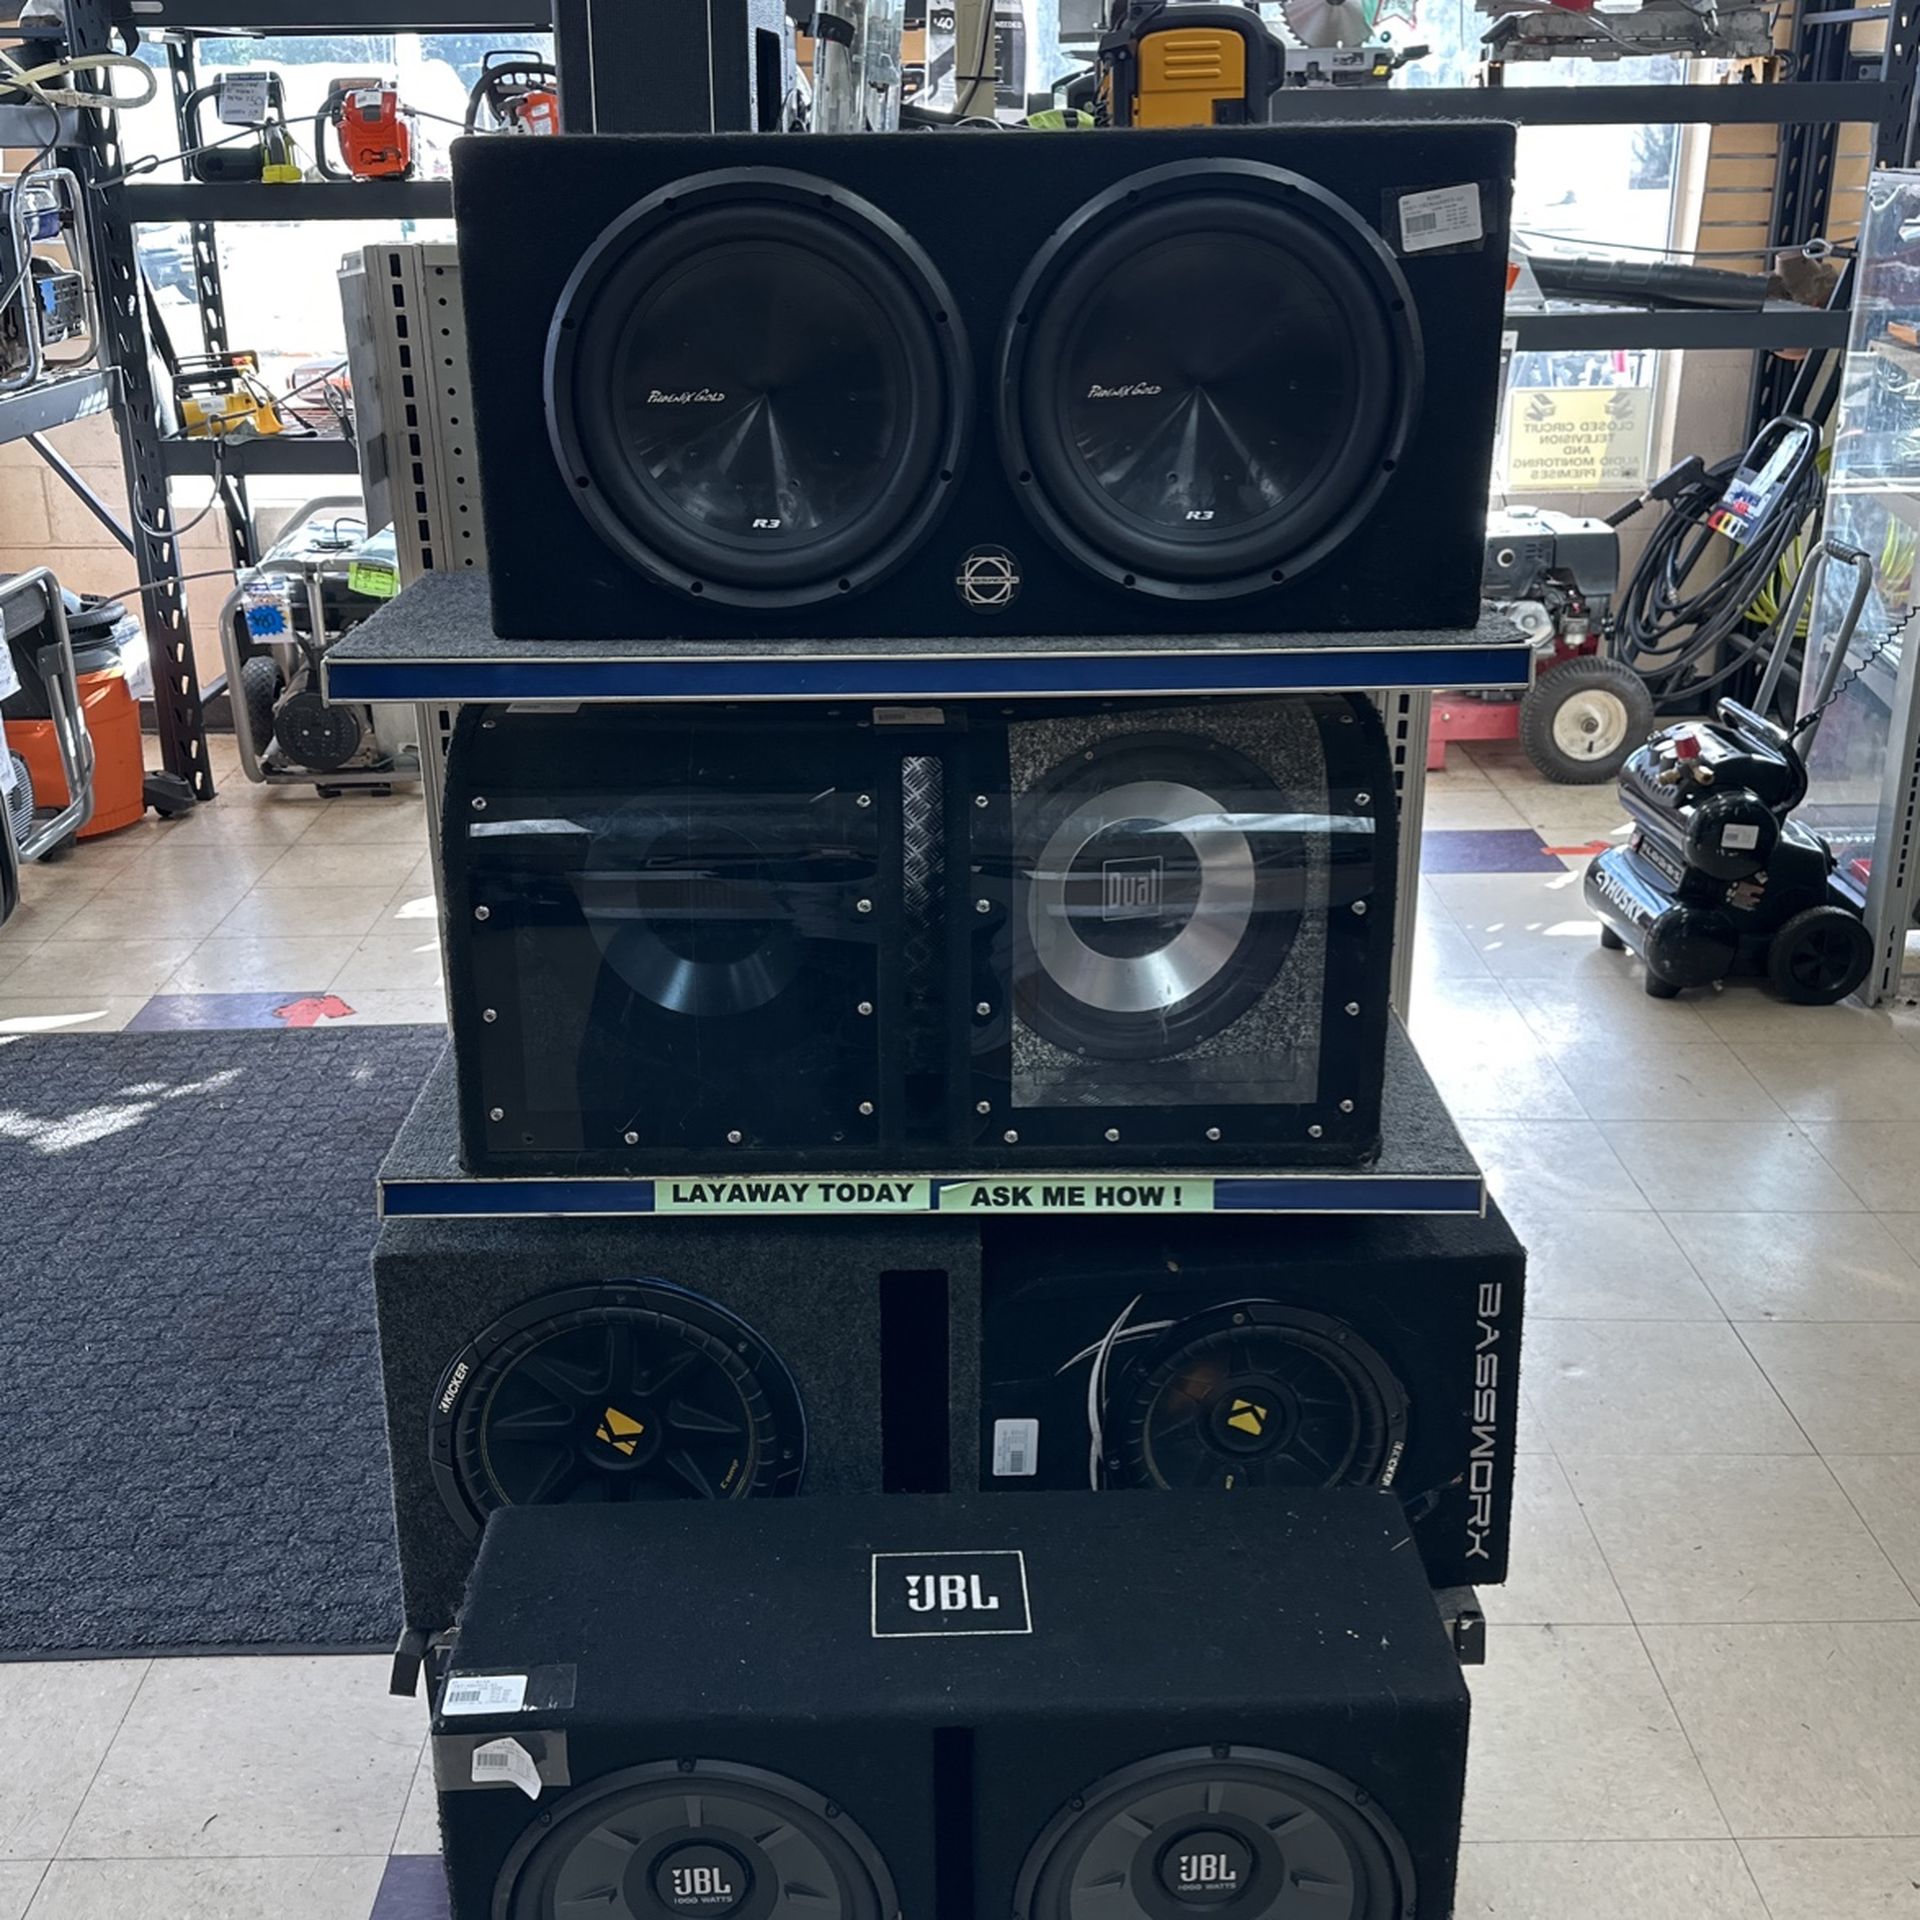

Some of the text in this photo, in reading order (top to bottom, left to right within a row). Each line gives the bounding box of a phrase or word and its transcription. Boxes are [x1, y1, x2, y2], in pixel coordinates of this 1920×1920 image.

[752, 519, 781, 529] R3
[1185, 511, 1215, 520] R3
[1109, 869, 1156, 909] Dual
[1605, 879, 1646, 924] HUSKY
[672, 1184, 915, 1203] LAYAWAY TODAY
[970, 1186, 1033, 1207] ASK
[1042, 1186, 1085, 1207] ME
[1095, 1186, 1165, 1207] HOW
[441, 1362, 469, 1407] KICKER
[1465, 1282, 1502, 1560] BASSWORX
[905, 1574, 999, 1612] JBL
[672, 1867, 731, 1895] JBL
[1180, 1854, 1236, 1882] JBL
